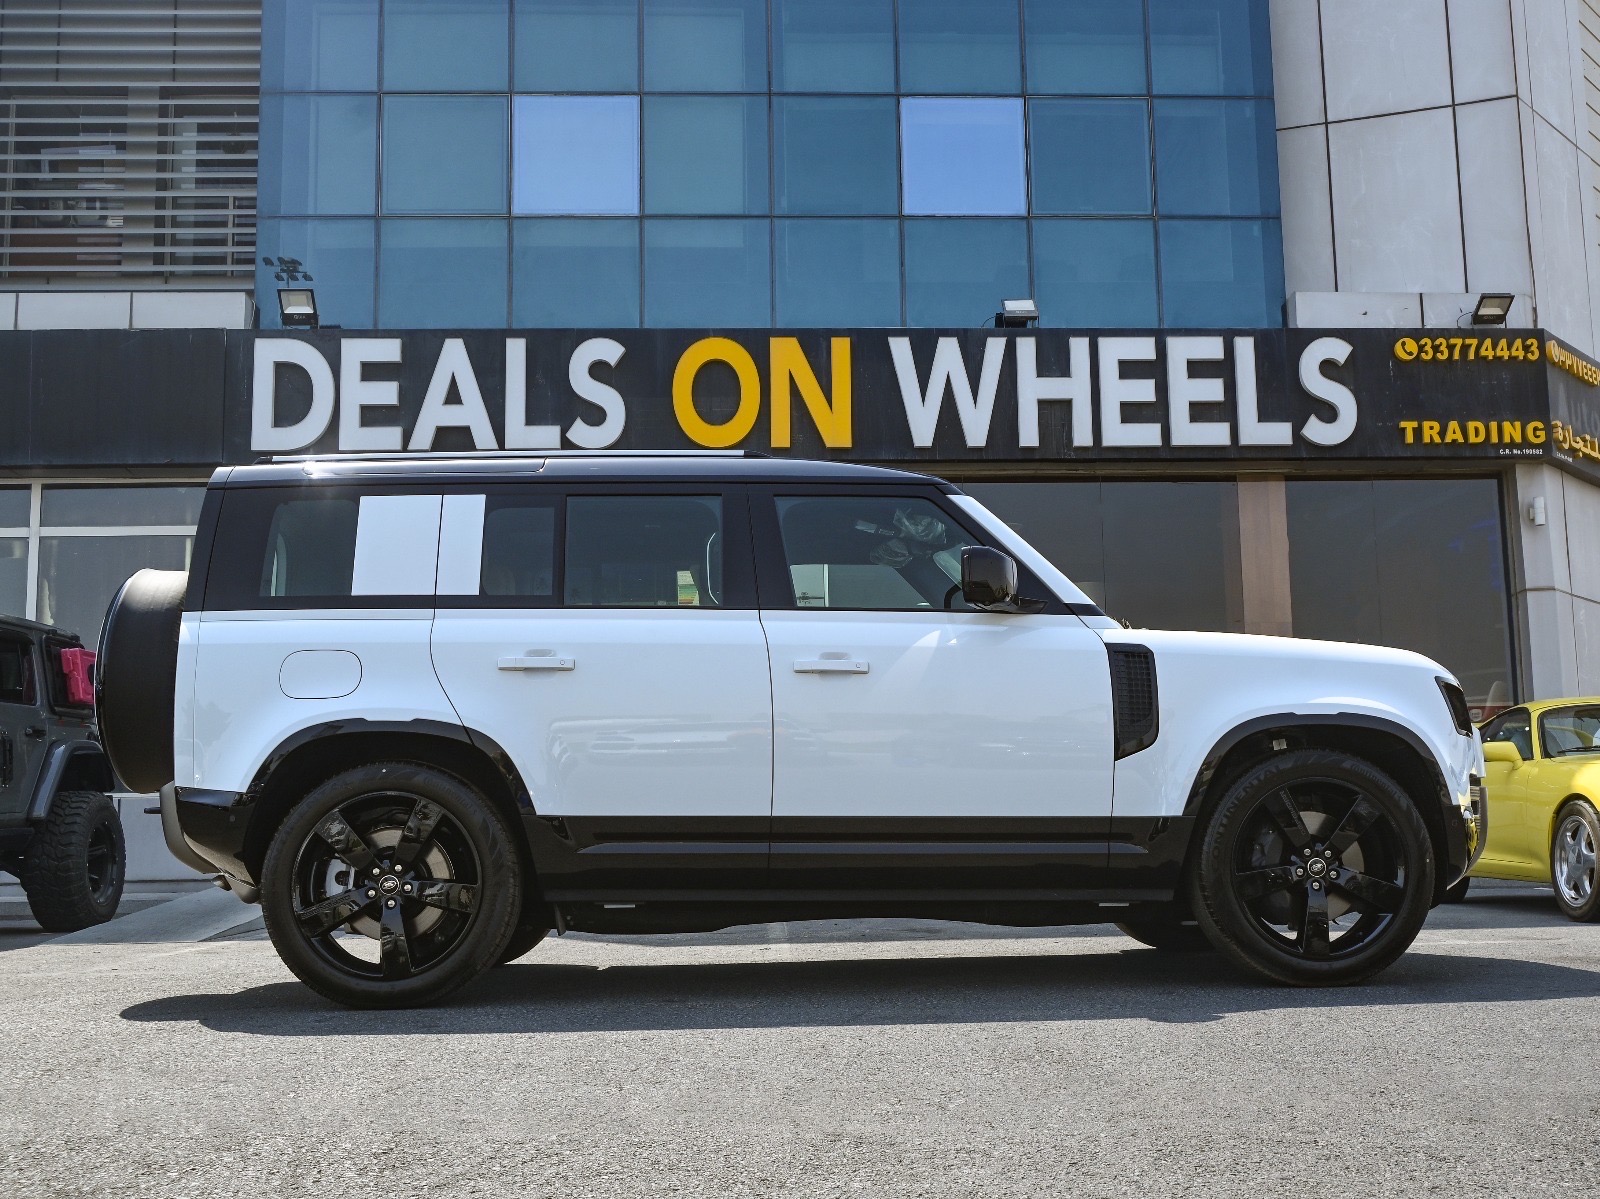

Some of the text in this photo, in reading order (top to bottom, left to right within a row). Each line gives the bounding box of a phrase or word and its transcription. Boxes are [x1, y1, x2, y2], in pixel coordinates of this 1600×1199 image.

[1418, 337, 1540, 361] 33774443
[251, 337, 1357, 450] DEALS ON WHEELS
[1399, 420, 1546, 444] TRADING
